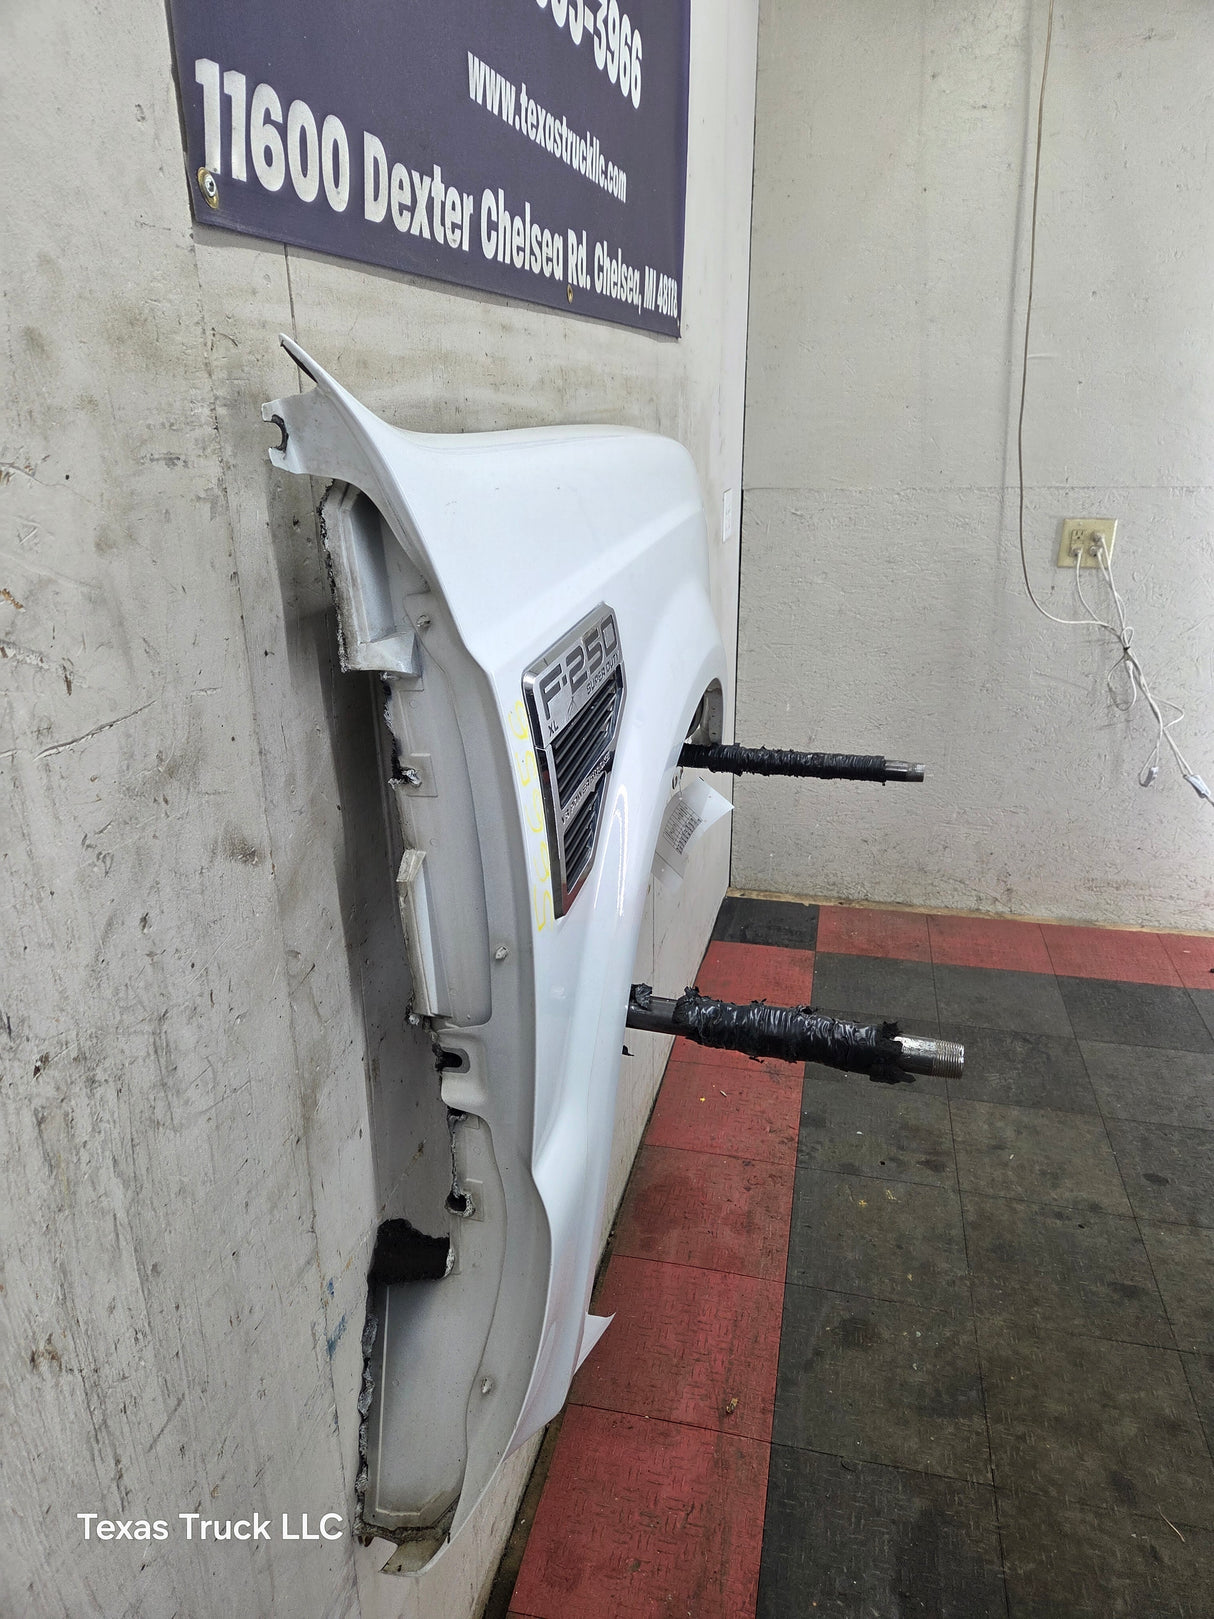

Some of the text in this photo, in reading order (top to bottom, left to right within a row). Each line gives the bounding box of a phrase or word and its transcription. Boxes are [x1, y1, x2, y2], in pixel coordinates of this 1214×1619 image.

[467, 51, 627, 203] www.texastruckllc.com
[195, 58, 678, 318] 11600 Dexter Chelsea Rd. Chelsea, MI 48118
[586, 651, 620, 695] SUPER DUTY
[547, 723, 560, 738] XL
